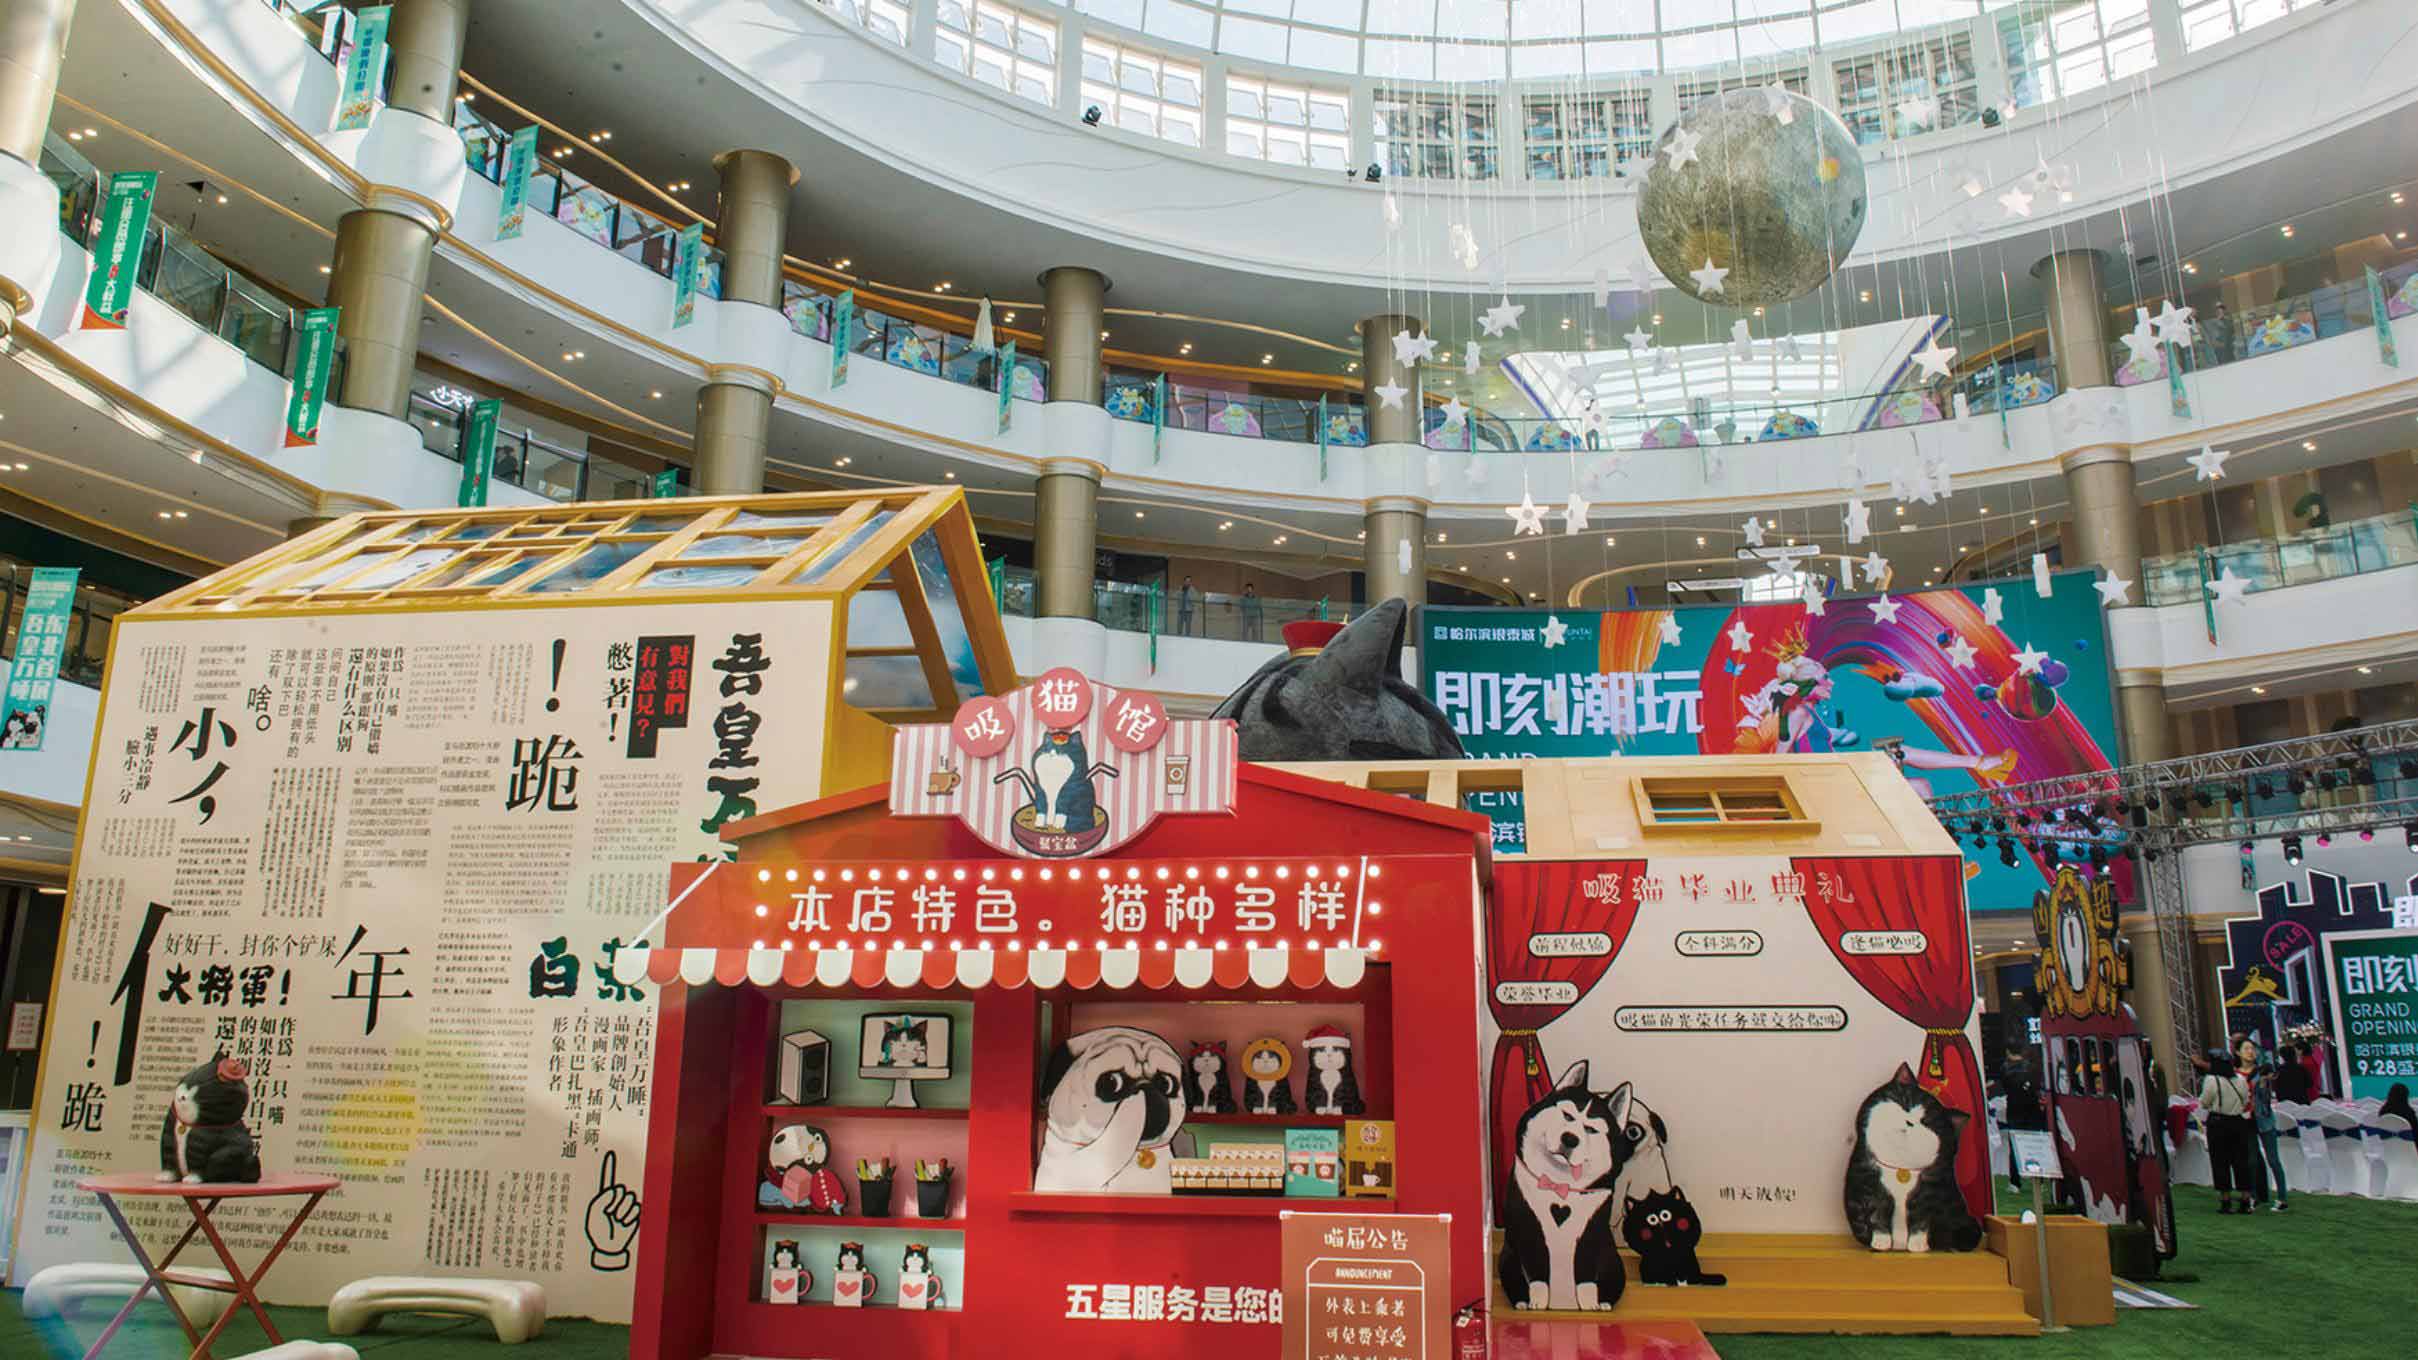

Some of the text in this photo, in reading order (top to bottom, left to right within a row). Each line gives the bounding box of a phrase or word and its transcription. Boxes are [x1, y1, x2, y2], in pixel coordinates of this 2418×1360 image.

[1450, 627, 1536, 641] 哈尔滨银泰城
[664, 645, 689, 716] 對我們
[964, 677, 1159, 745] 吸猫馆
[1434, 670, 1705, 736] 即刻潮玩
[505, 734, 585, 813] 跪
[788, 884, 1347, 934] 本店特色。猫种多样
[1534, 938, 1604, 953] 前程似锦
[1685, 936, 1756, 951] 全科满分
[1849, 935, 1923, 951] 逢猫必吸
[2270, 927, 2303, 958] SALE
[331, 924, 414, 1036] 年
[1502, 985, 1572, 1001] 荣誉毕业
[2349, 1003, 2409, 1018] GRAND
[2352, 1020, 2418, 1036] OPENIN
[549, 1016, 569, 1092] 形象作者
[60, 1081, 105, 1132] 跪
[1324, 1227, 1409, 1250] 喵届公告
[1326, 1326, 1407, 1348] 可免费享受
